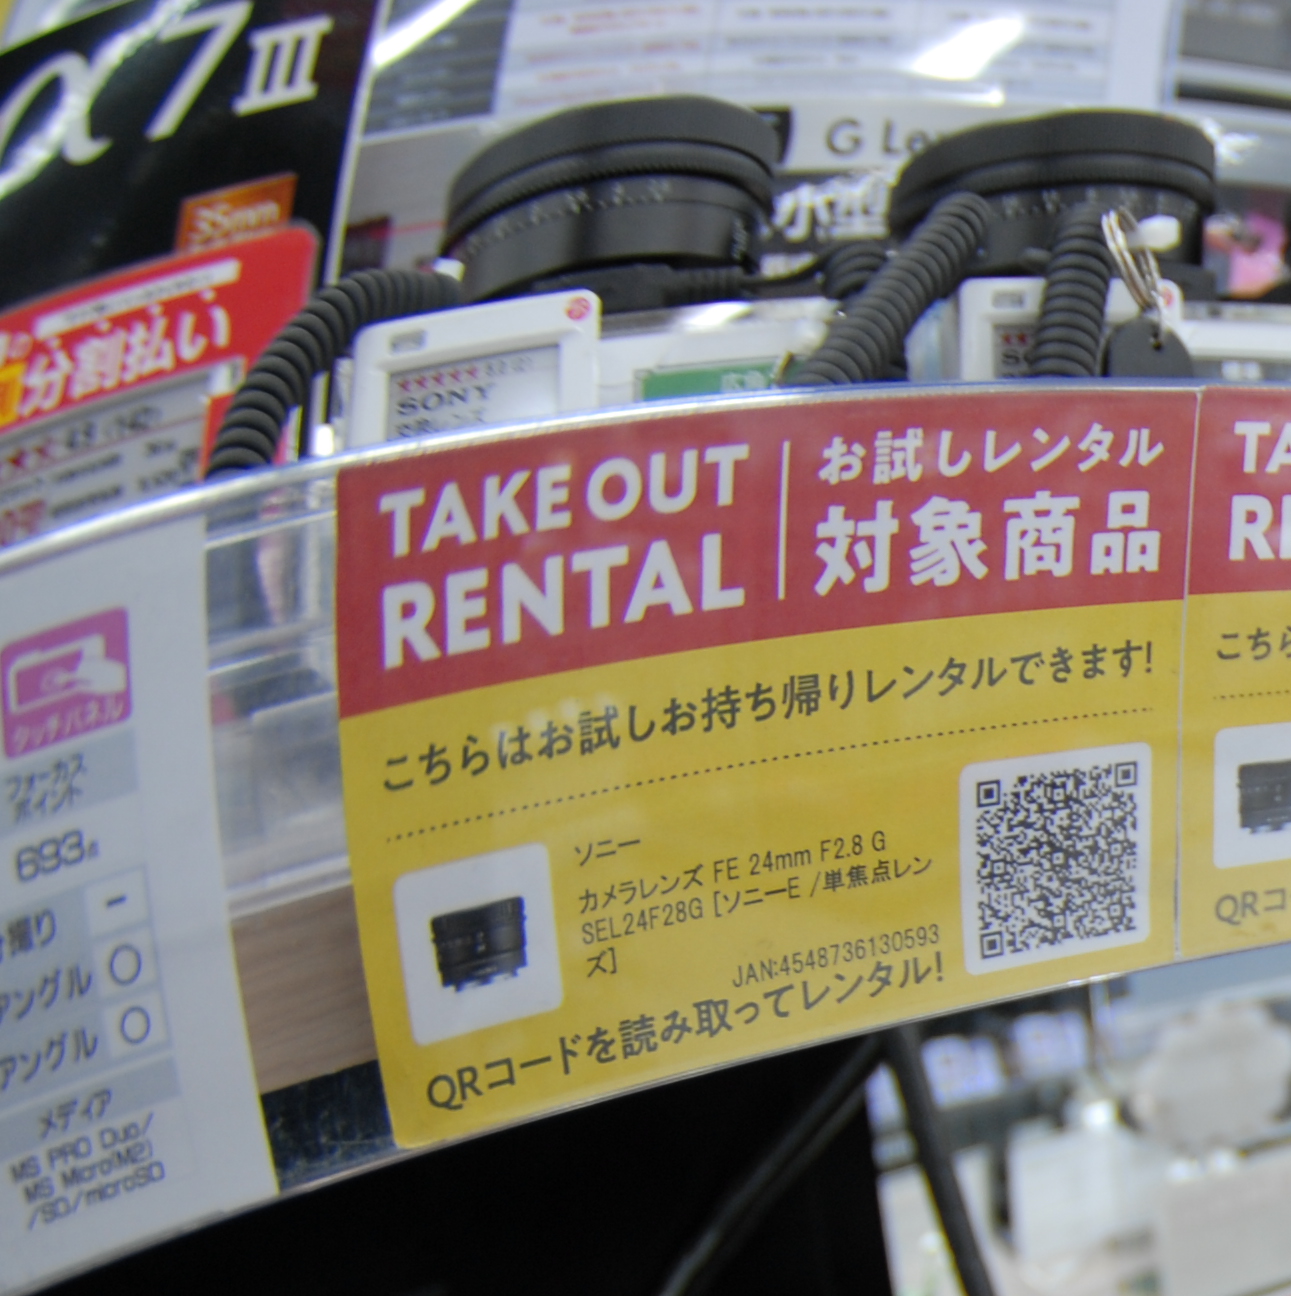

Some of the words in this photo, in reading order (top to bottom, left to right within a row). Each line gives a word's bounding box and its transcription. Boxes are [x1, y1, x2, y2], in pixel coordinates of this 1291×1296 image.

[826, 116, 861, 156] G
[379, 464, 572, 558] TAKE
[586, 443, 750, 522] OUT
[818, 422, 1165, 486] お試しレンタル
[814, 489, 1161, 597] 対象商品
[381, 533, 746, 670] RENTAL
[384, 640, 1153, 791] こちらはお試しお持ち帰りレンタルできます!
[574, 838, 641, 867] ソニー
[578, 866, 703, 914] カメラレンズ
[713, 856, 740, 883] FE
[749, 846, 812, 876] 24mm
[820, 833, 864, 861] F2.8
[872, 830, 887, 853] G
[581, 896, 704, 946] SEL24F28G
[427, 951, 945, 1111] QRコードを読み取ってレンタル!
